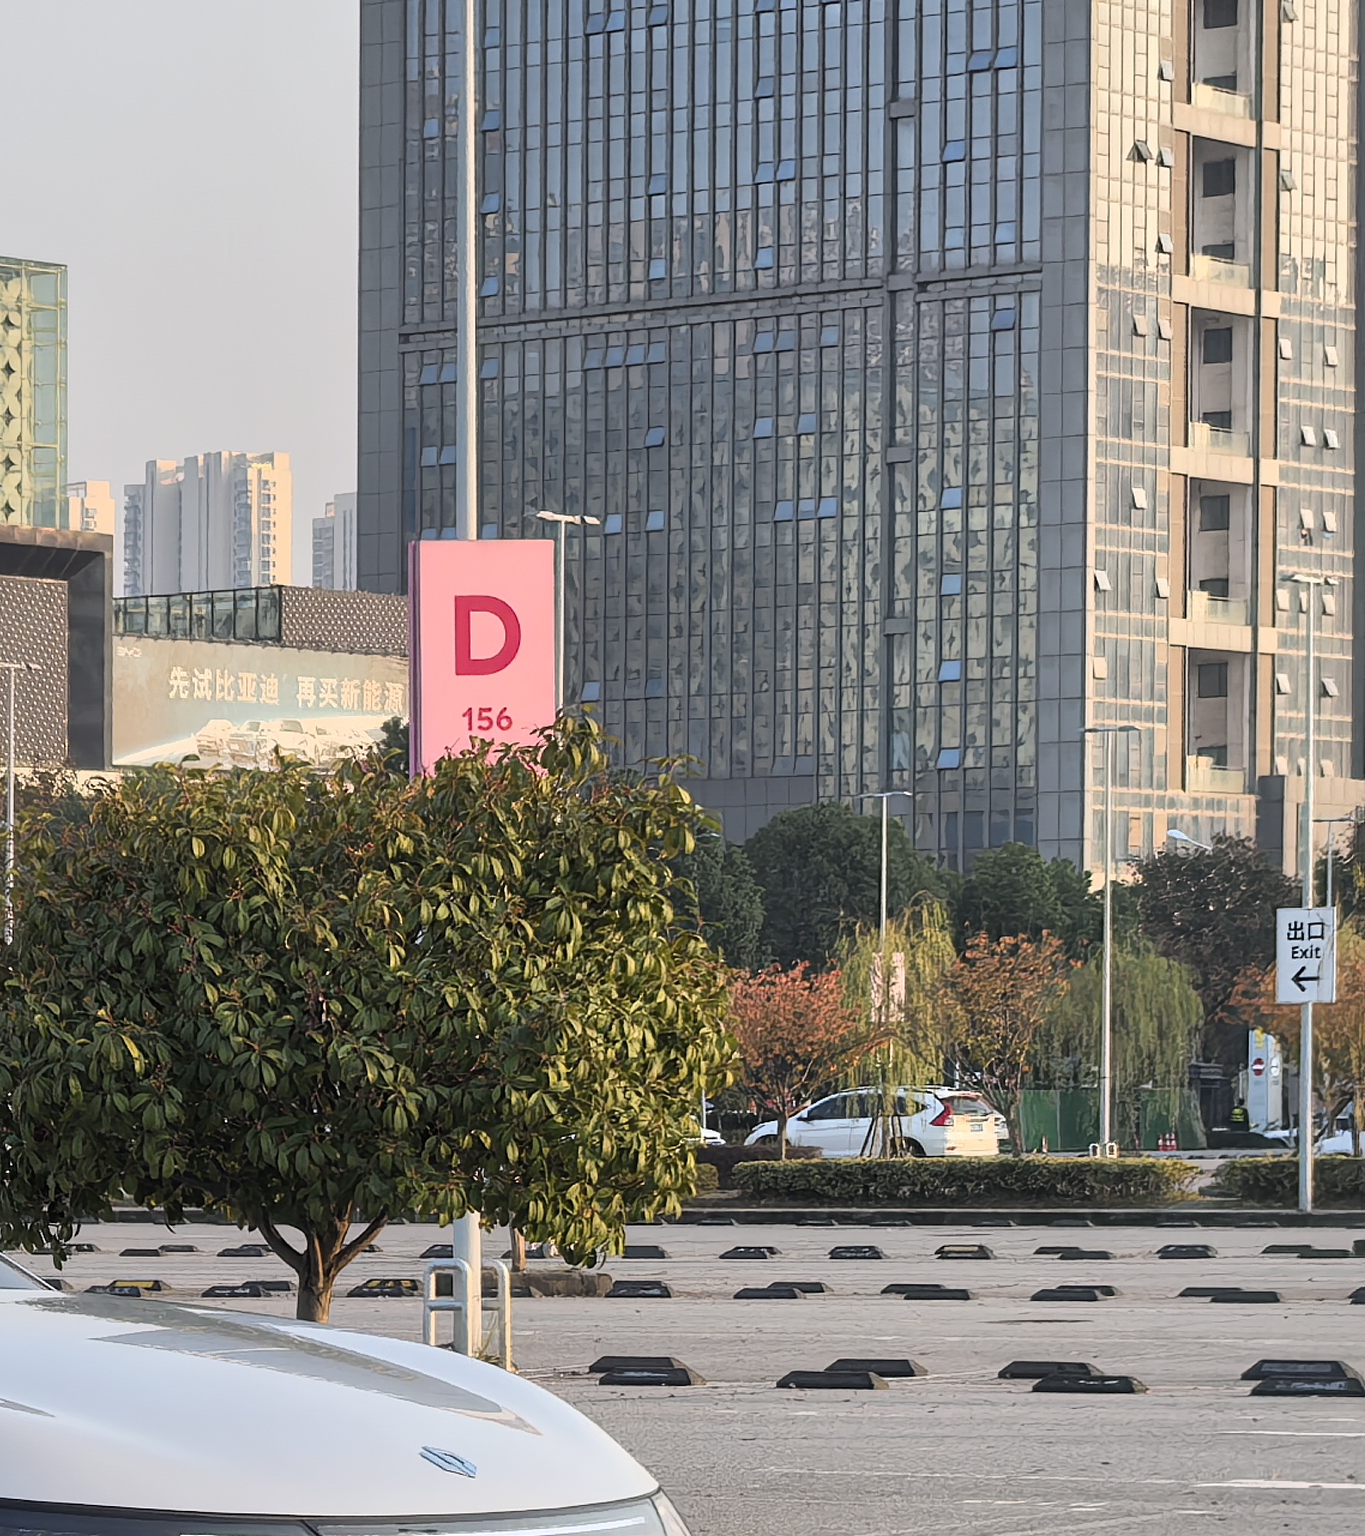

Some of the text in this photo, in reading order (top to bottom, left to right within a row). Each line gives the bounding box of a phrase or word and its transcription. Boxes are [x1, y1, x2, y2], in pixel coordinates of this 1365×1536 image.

[454, 594, 522, 676] D
[168, 665, 405, 713] 先试比亚迪 再买新能源
[461, 706, 514, 732] 156
[1286, 920, 1325, 942] 出口
[1291, 944, 1322, 960] Exit
